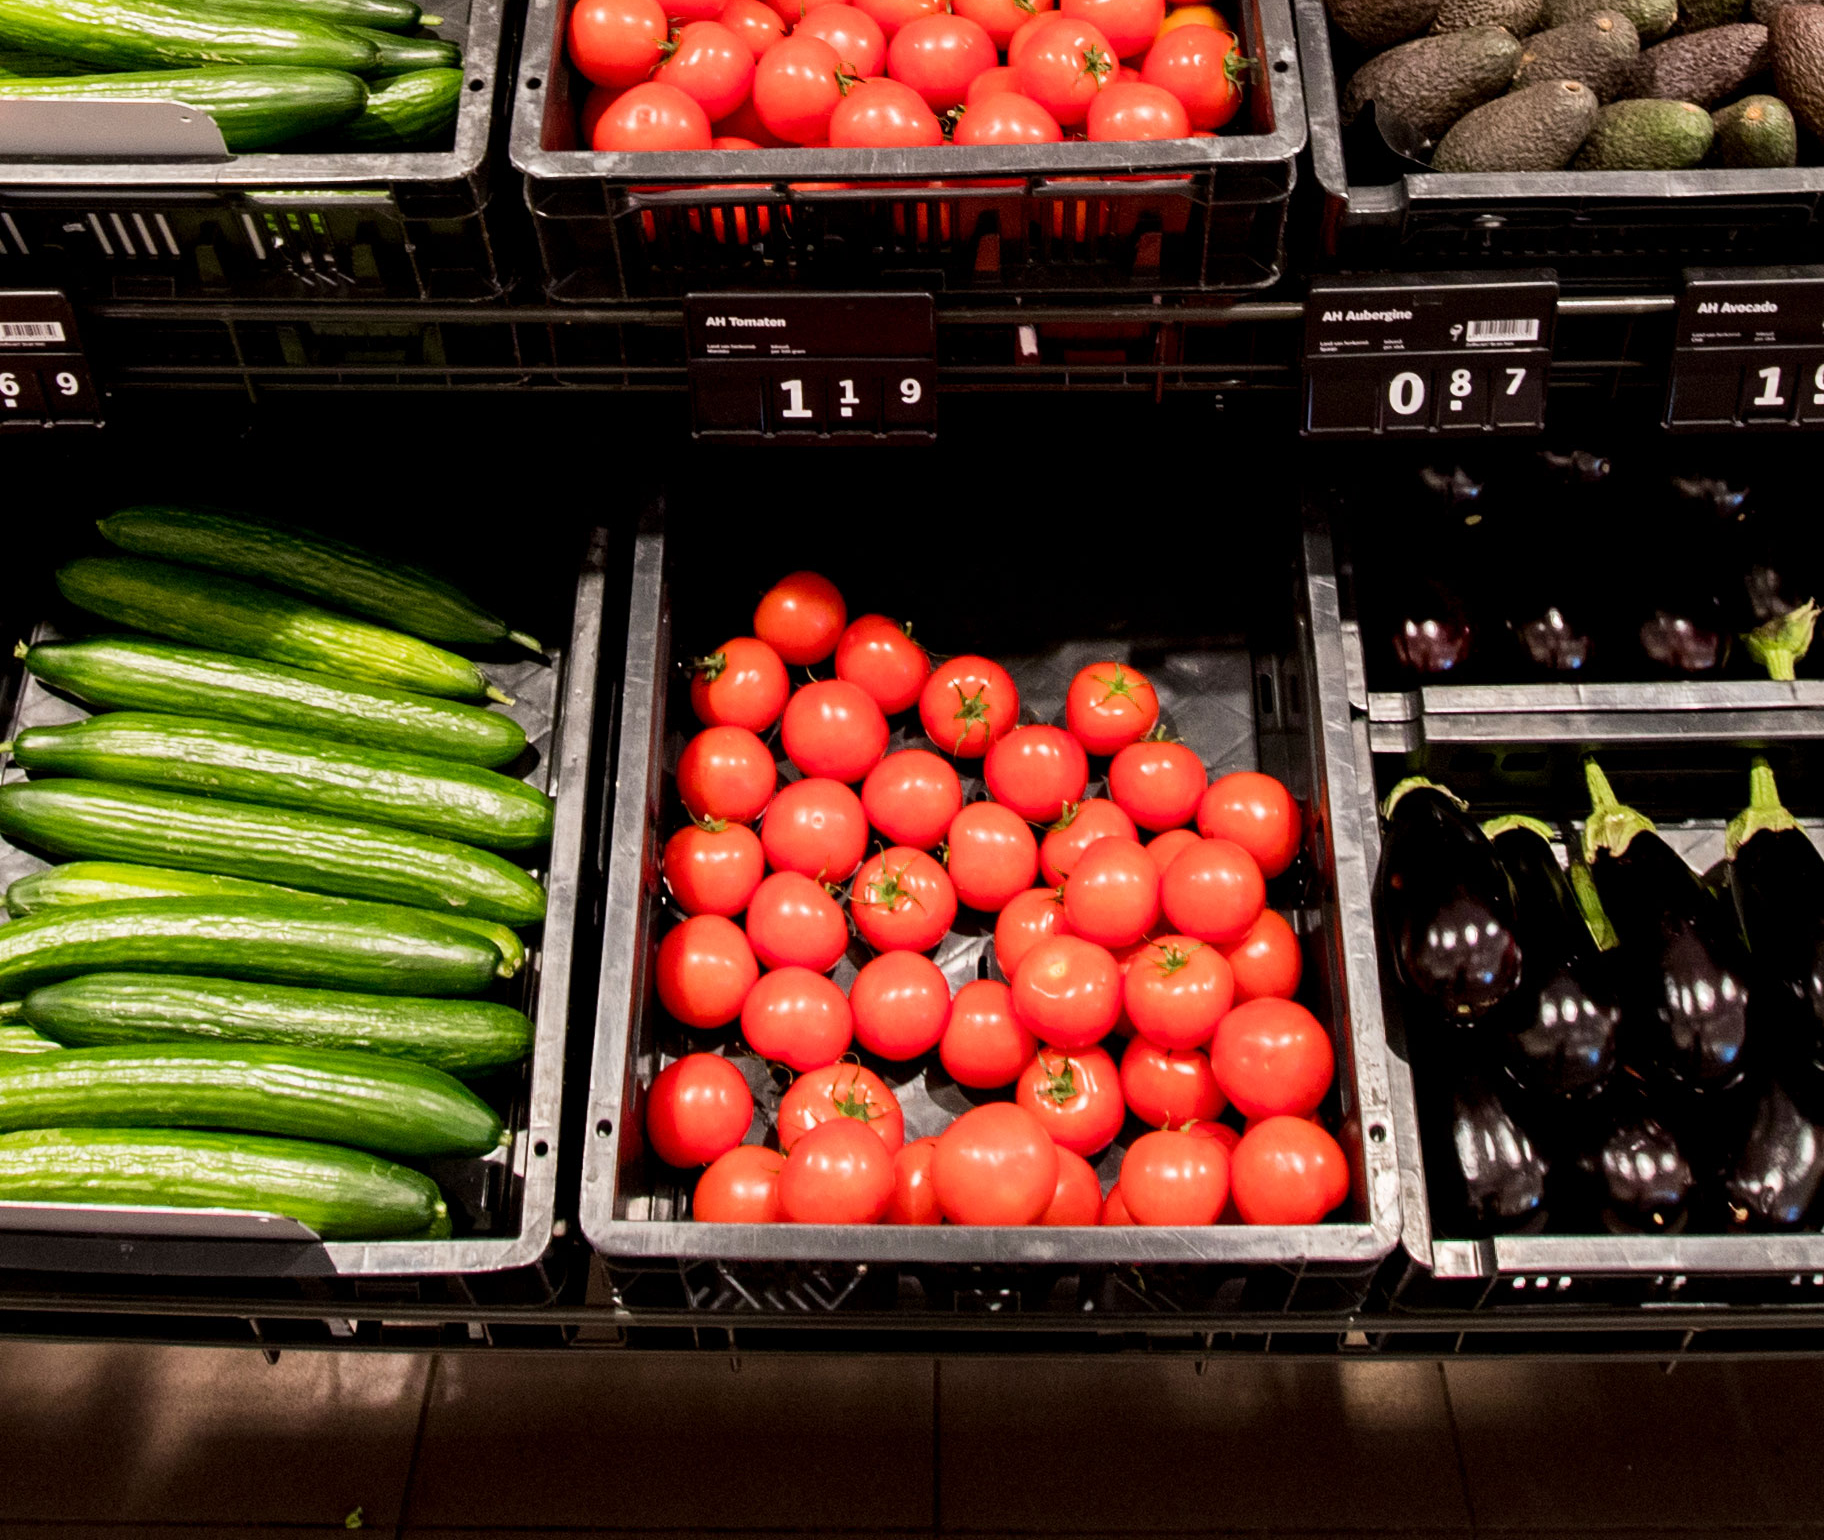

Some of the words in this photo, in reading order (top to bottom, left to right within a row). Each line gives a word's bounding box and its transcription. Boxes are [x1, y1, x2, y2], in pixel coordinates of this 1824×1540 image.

[1697, 302, 1718, 314] AH
[1720, 301, 1778, 314] Avocado
[705, 316, 726, 327] AH
[728, 316, 786, 327] Tomaten
[1322, 311, 1343, 322] AH
[1345, 309, 1413, 323] Aubergine
